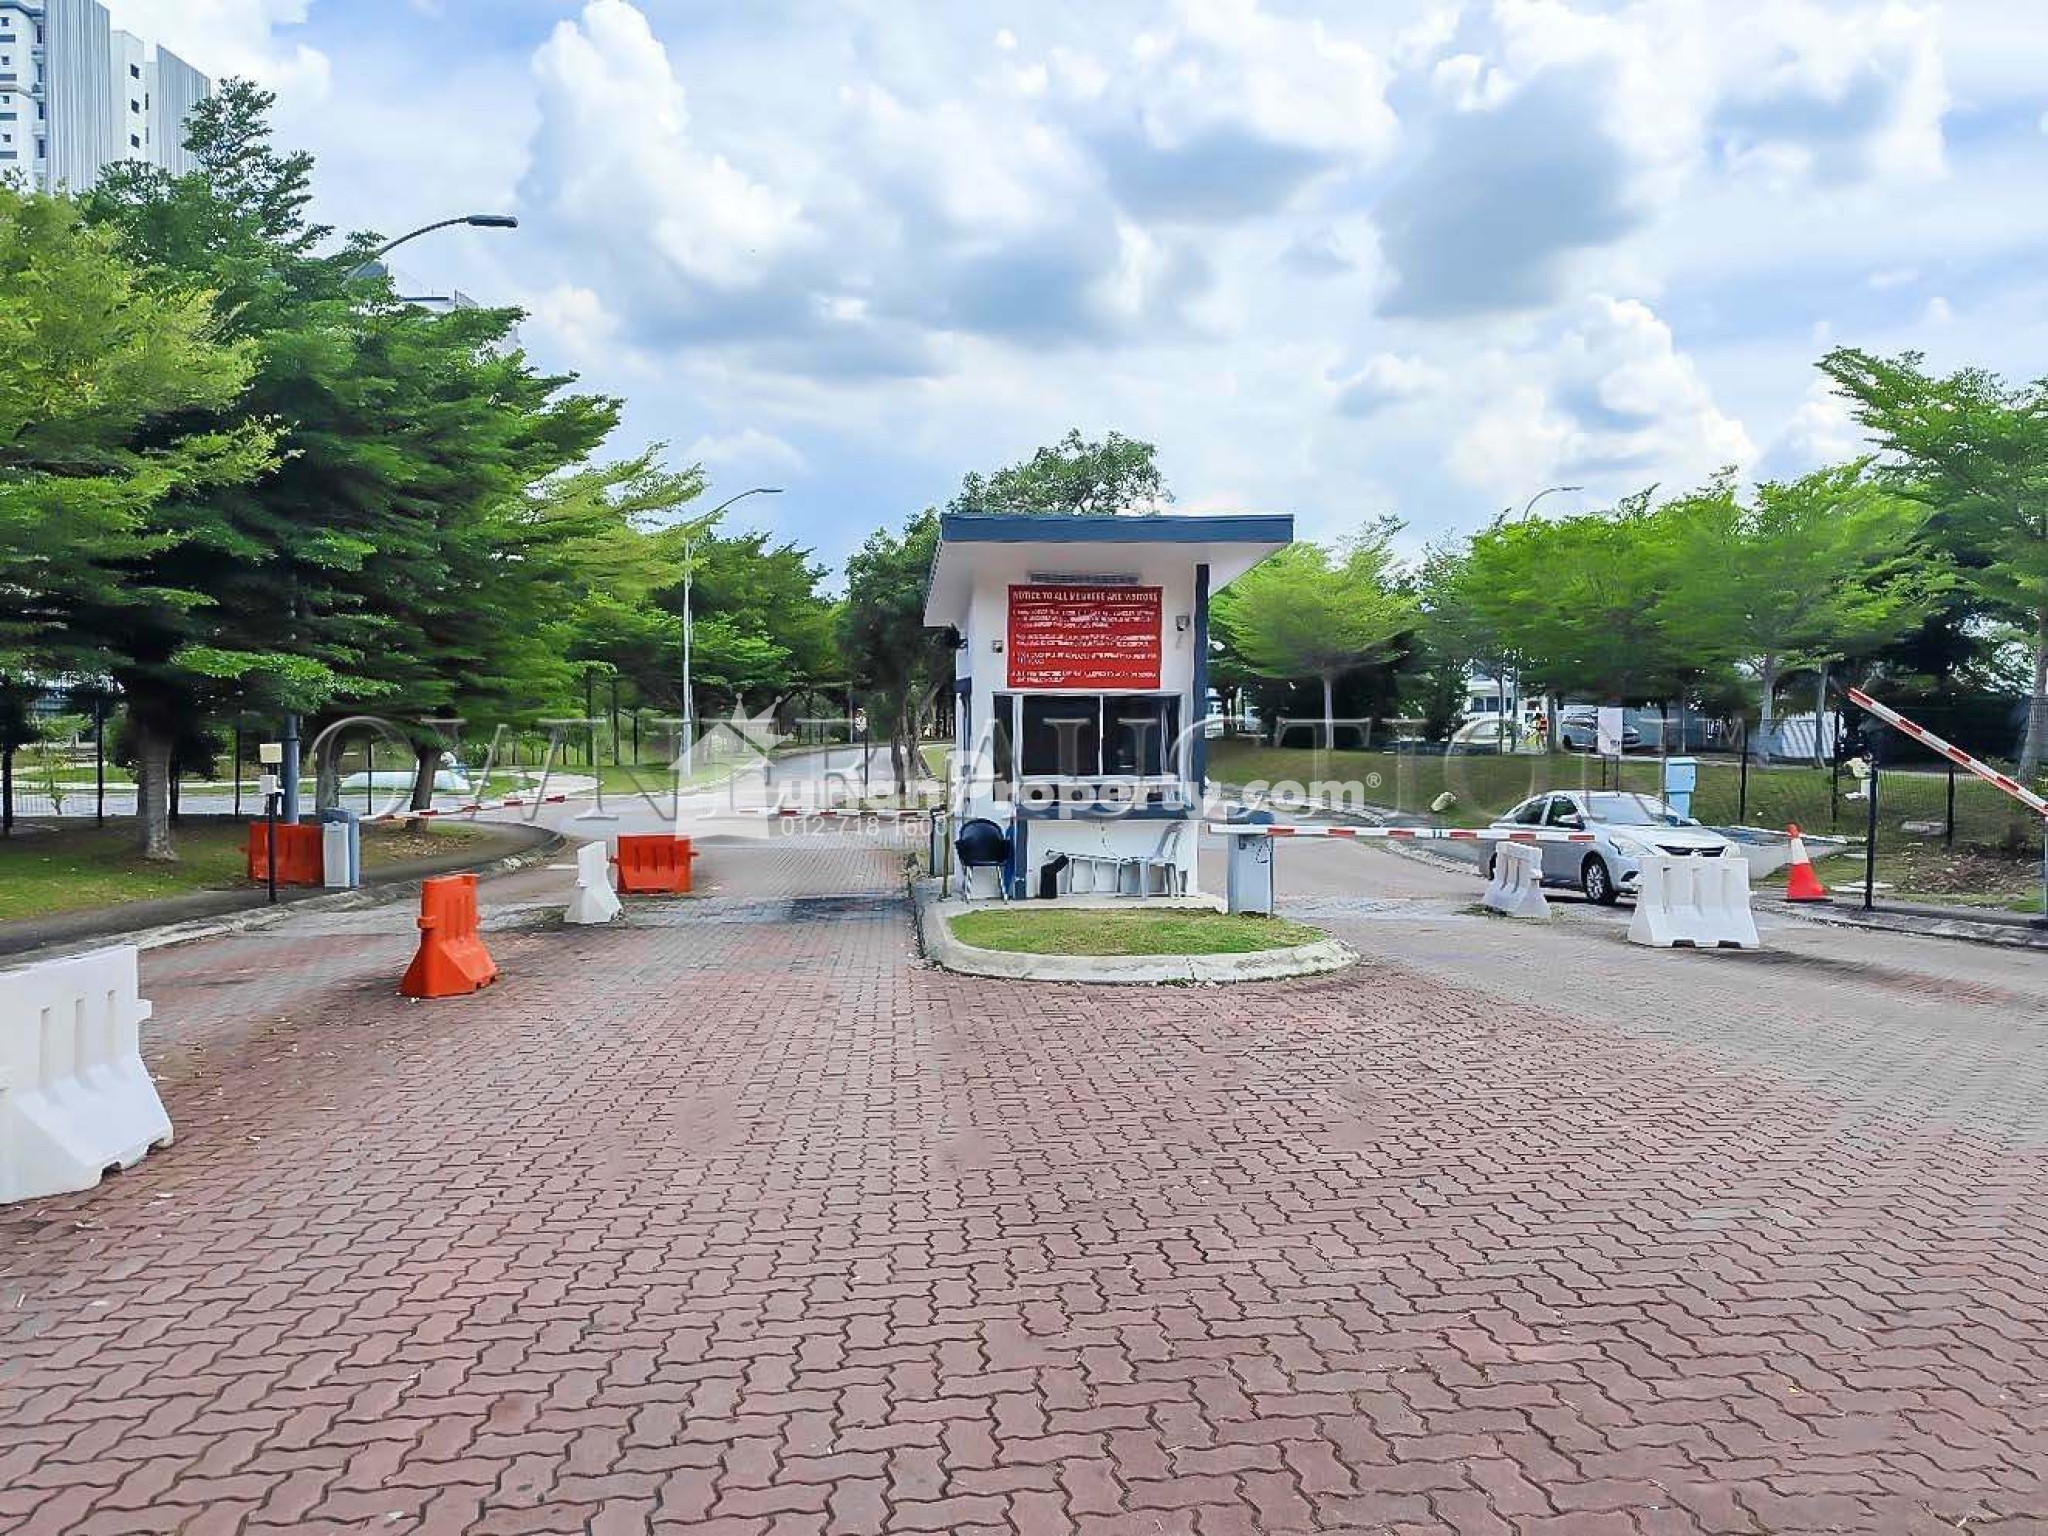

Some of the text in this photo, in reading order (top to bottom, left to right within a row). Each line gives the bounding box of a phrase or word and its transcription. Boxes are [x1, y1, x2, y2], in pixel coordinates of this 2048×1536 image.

[1013, 590, 1041, 601] NOTICE
[1041, 590, 1053, 600] TO
[1054, 591, 1067, 601] ALL
